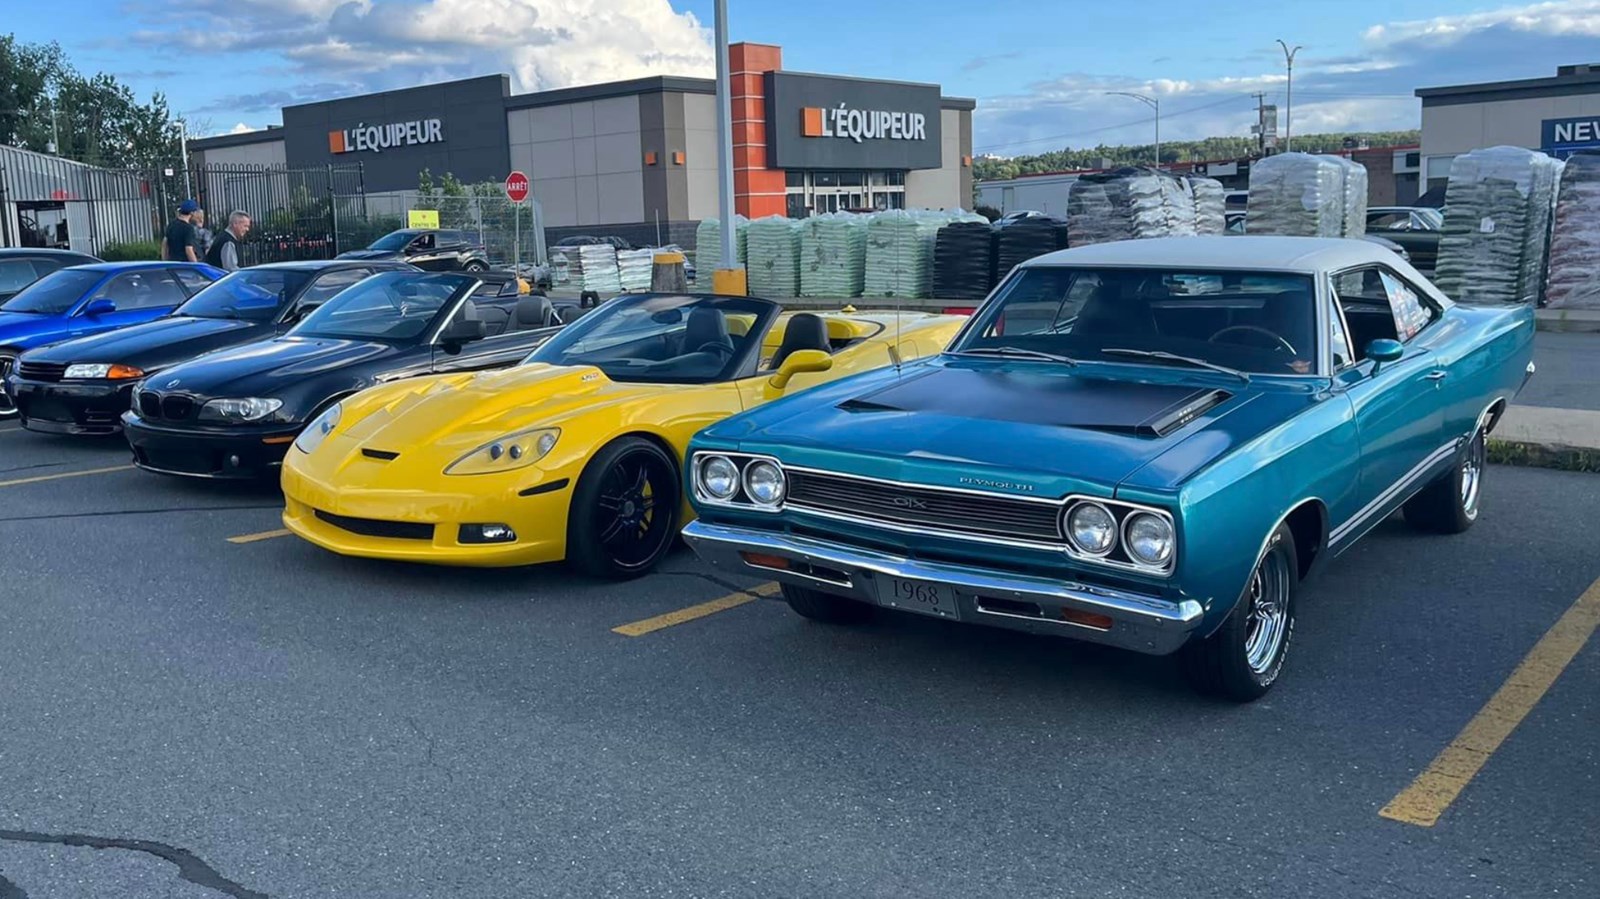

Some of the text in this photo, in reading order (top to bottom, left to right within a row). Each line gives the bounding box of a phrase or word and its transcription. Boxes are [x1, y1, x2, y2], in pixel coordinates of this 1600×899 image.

[343, 119, 442, 152] L'ÉQUIPEUR
[821, 102, 925, 142] L'ÉQUIPEUR
[507, 181, 527, 191] ARRÊT
[960, 477, 1033, 491] PLYMOUTH
[893, 579, 939, 606] 1968
